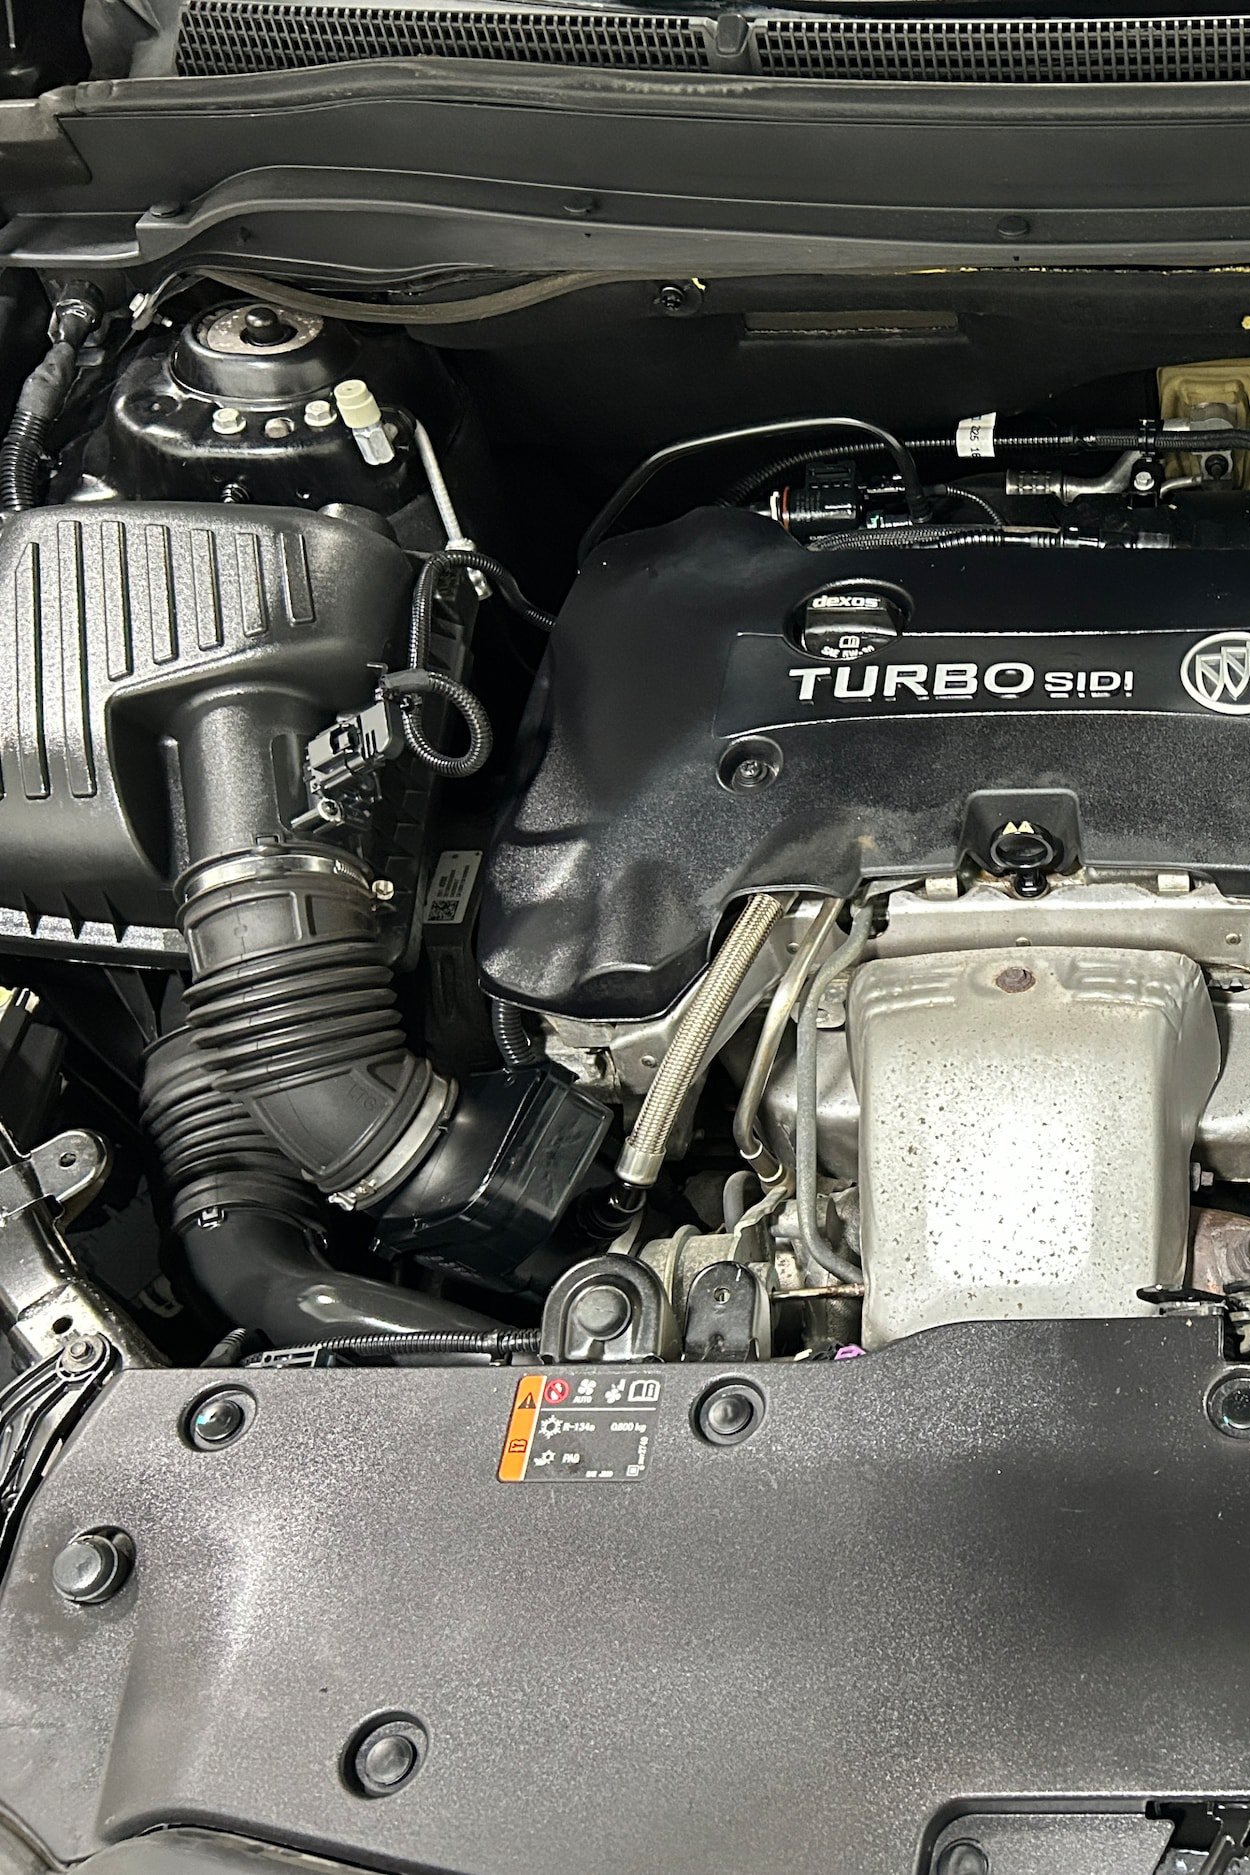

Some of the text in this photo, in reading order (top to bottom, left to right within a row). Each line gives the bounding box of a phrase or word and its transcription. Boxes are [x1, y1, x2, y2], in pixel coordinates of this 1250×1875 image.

[812, 595, 880, 608] dexos
[789, 662, 1134, 701] TURBO SIDI
[572, 1395, 593, 1404] AUTO
[562, 1422, 596, 1432] R-134a
[634, 1422, 647, 1433] kg
